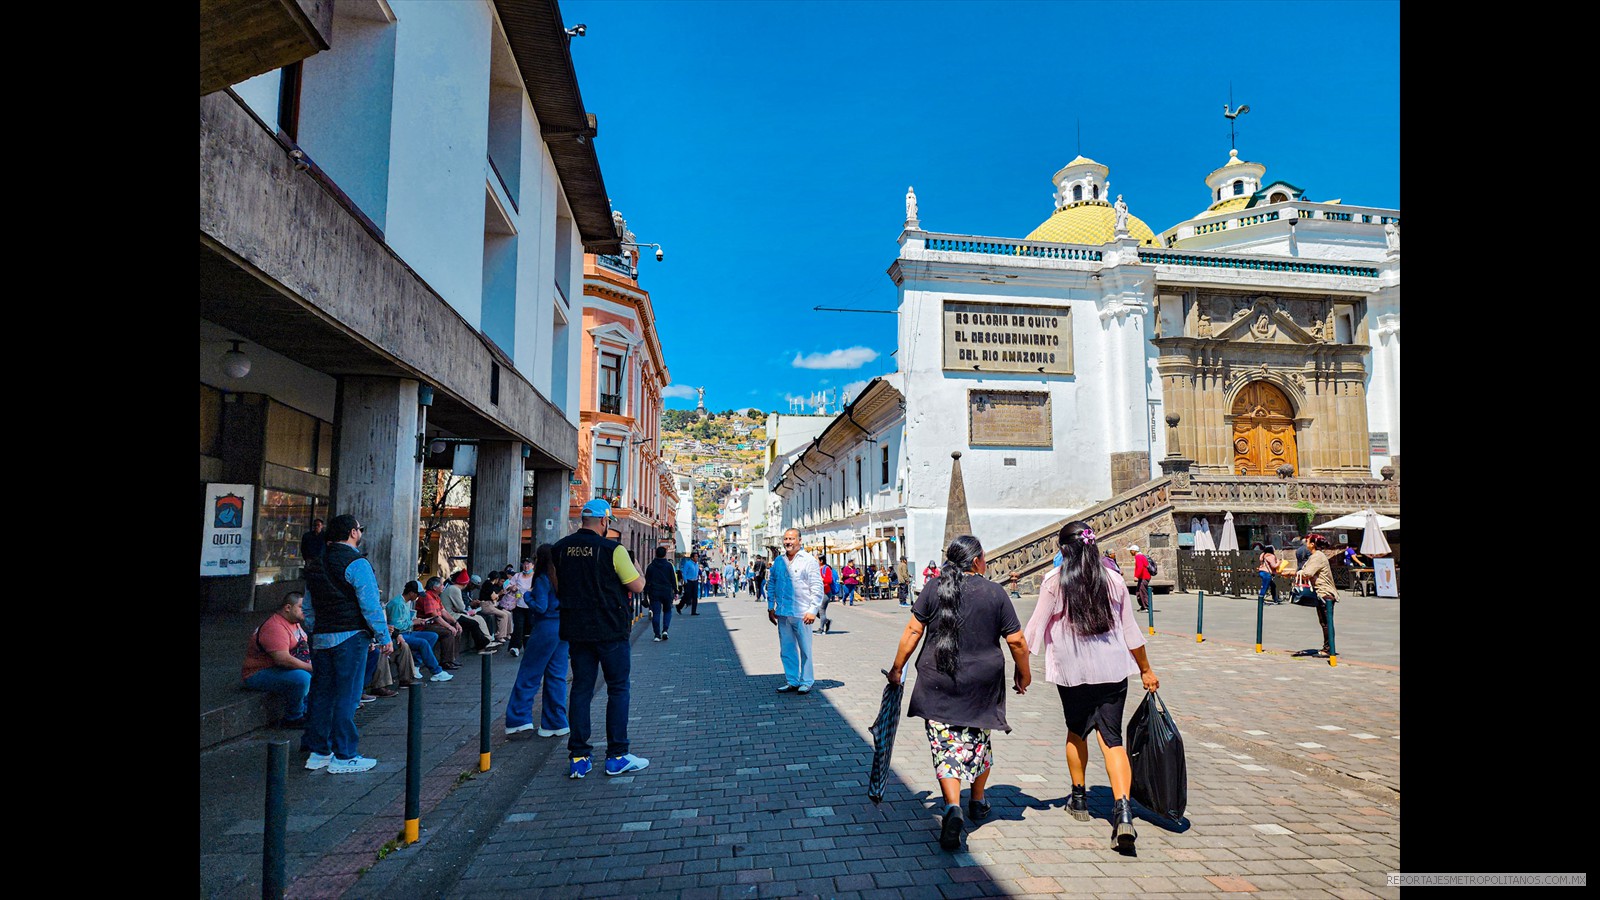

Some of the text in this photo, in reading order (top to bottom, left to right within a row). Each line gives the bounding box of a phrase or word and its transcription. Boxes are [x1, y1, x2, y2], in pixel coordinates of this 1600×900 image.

[956, 313, 1058, 329] ES GLORIA DE QUITO
[955, 331, 1059, 346] EL DESCUBRIMIENTO
[959, 348, 1056, 364] DEL RIO AMAZONAS
[212, 533, 242, 546] QUITO
[567, 546, 593, 557] PRENSA
